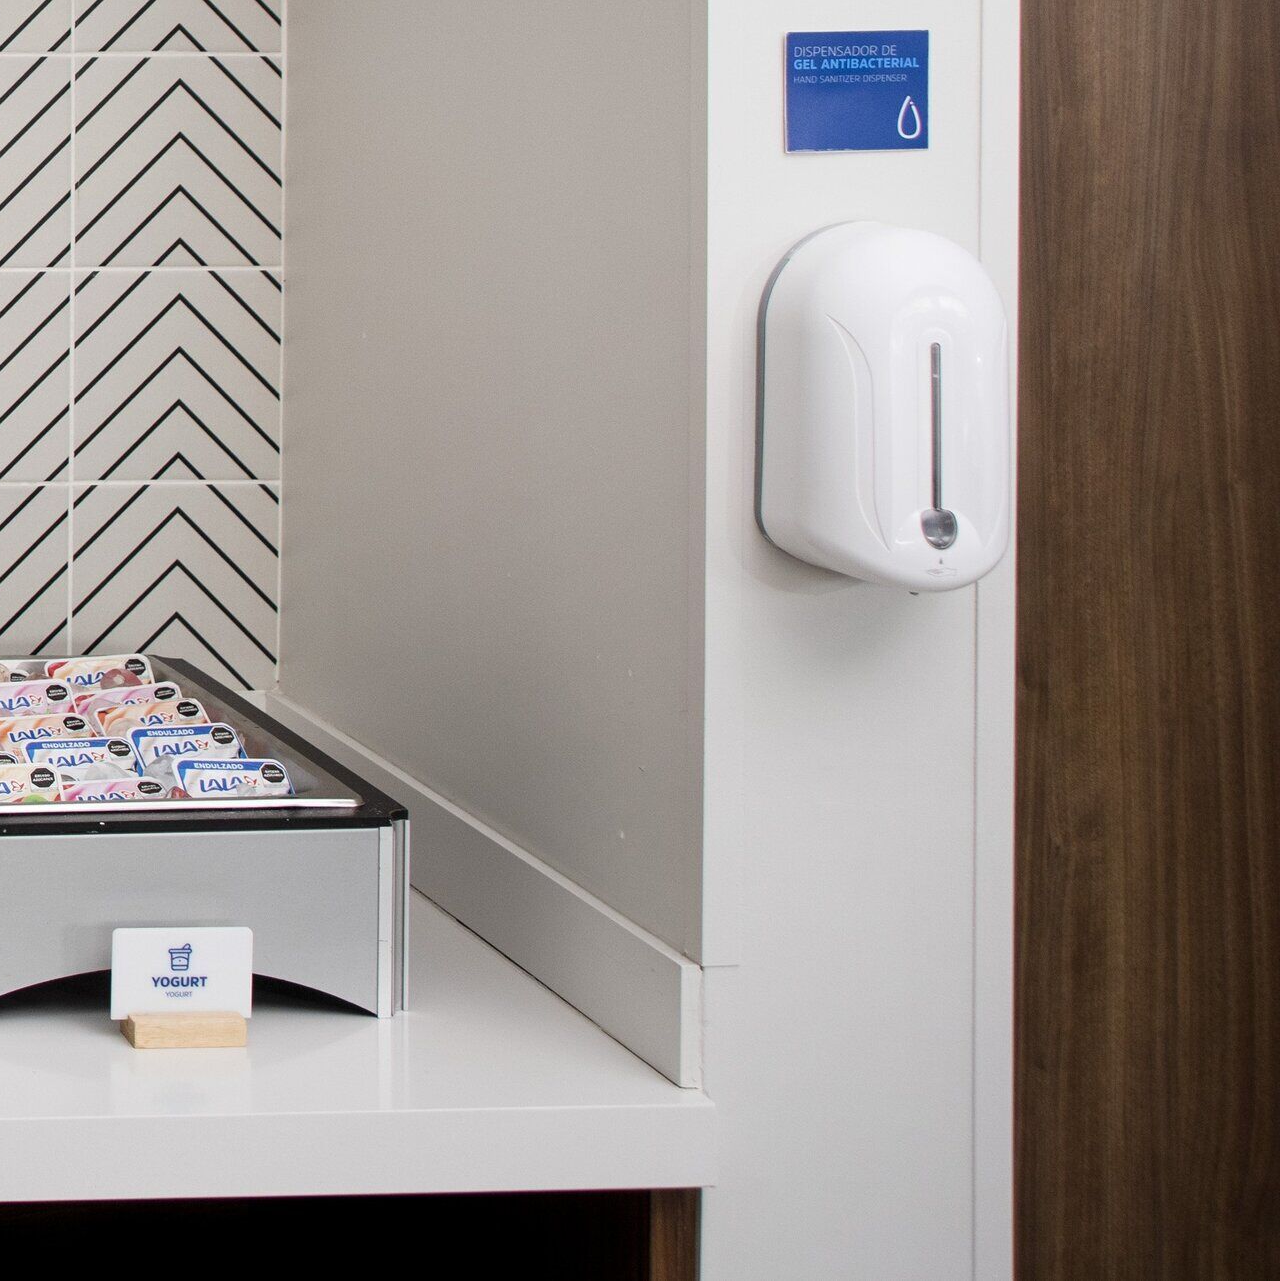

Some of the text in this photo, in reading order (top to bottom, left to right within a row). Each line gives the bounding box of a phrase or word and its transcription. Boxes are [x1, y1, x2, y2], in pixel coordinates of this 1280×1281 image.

[793, 44, 897, 57] DISPENSADOR DE
[793, 57, 919, 70] GEL ANTIBACTERIAL
[793, 74, 907, 84] HAND SANITIZER DISPENSER
[9, 727, 52, 743] LALA
[146, 729, 195, 737] ENDULZADO
[41, 741, 91, 749] ENDULZADO
[153, 740, 199, 758] LALA
[193, 762, 244, 770] ENDULZADO
[151, 976, 208, 987] YOGURT
